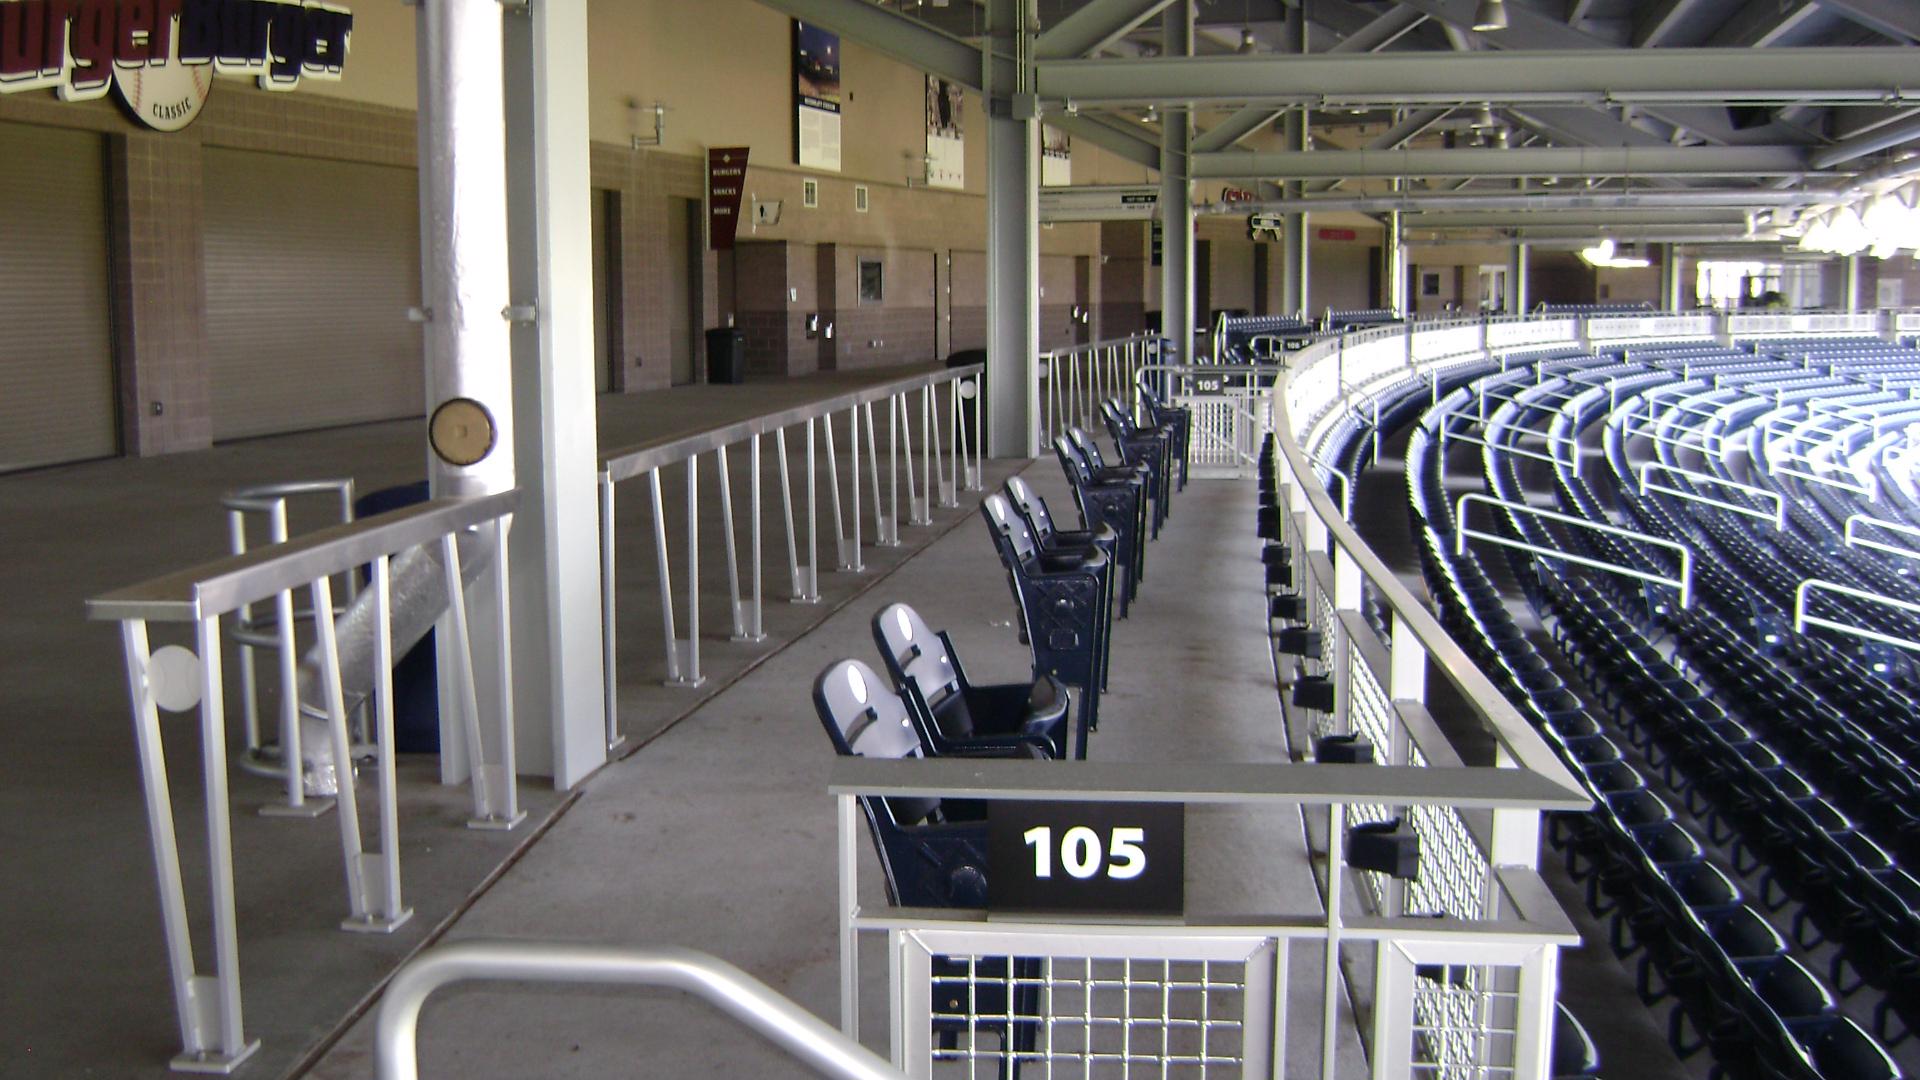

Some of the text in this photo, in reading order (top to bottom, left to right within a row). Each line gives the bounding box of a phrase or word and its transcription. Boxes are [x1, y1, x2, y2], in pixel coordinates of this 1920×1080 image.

[152, 98, 192, 121] CLASSIC
[712, 168, 741, 176] BURGERS
[1197, 379, 1219, 391] 105
[1023, 826, 1147, 880] 105
